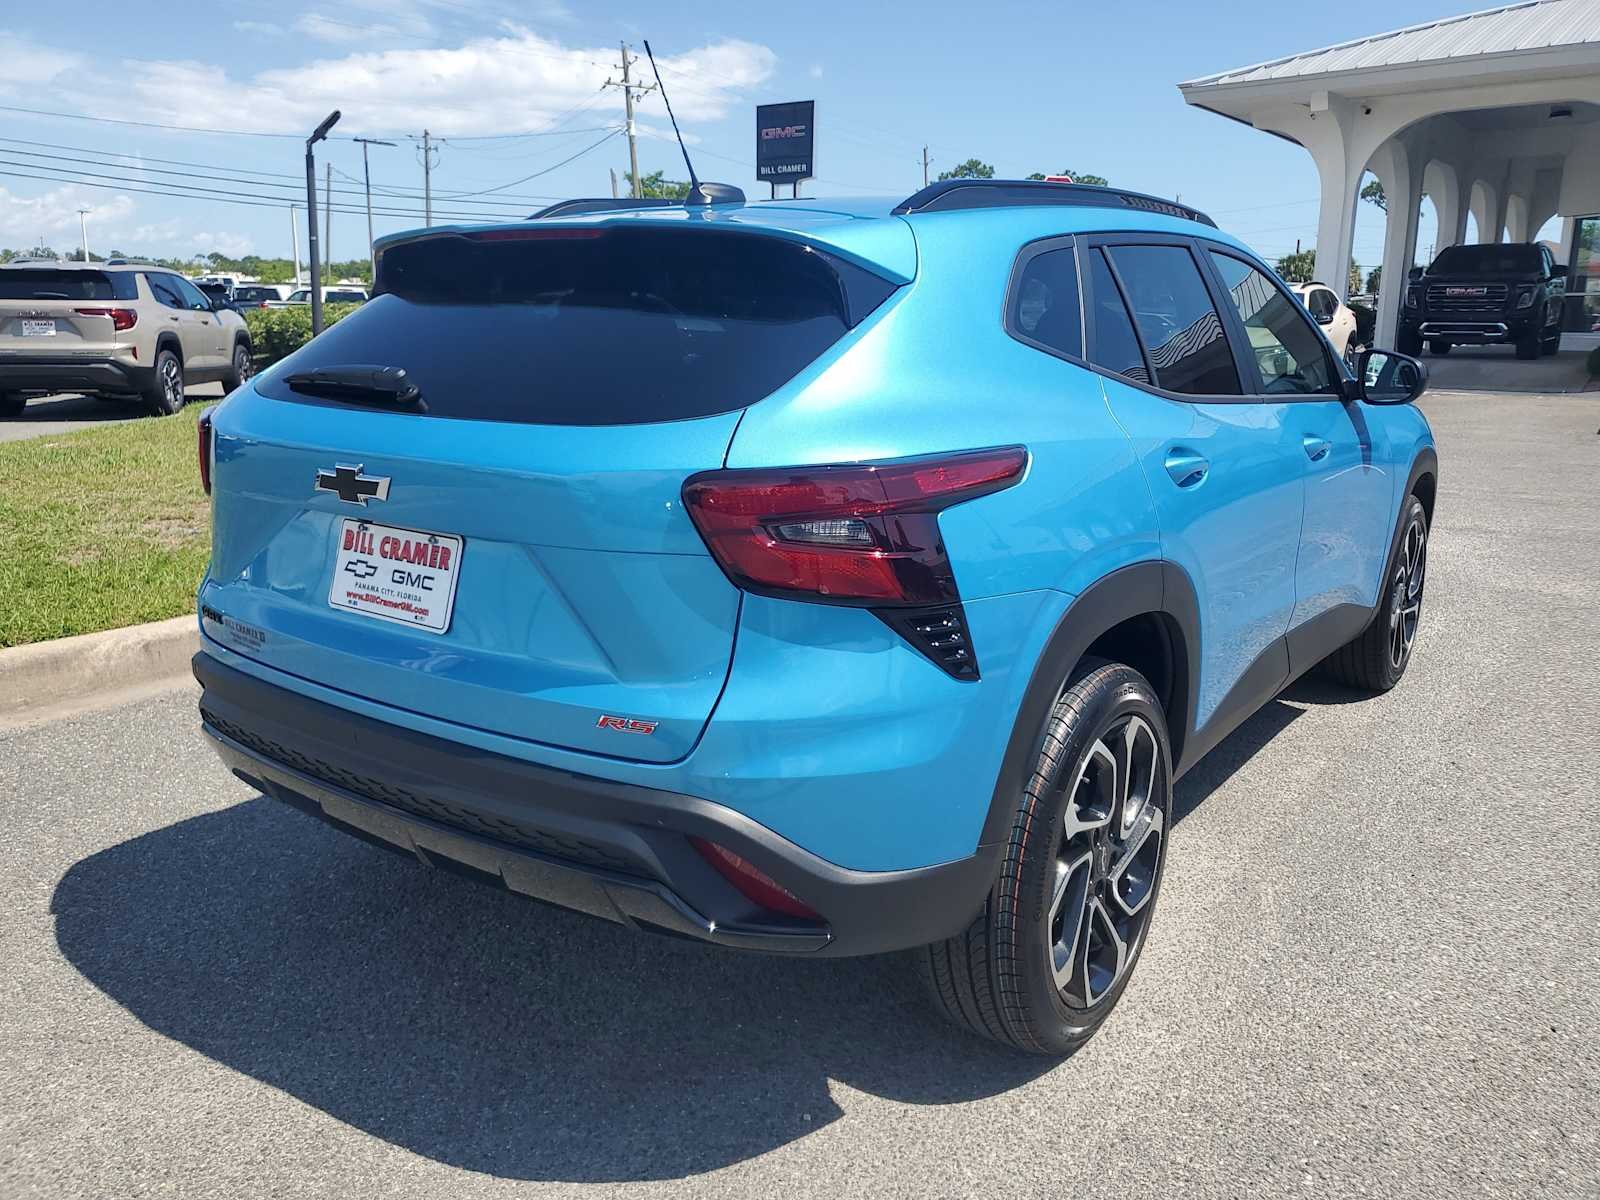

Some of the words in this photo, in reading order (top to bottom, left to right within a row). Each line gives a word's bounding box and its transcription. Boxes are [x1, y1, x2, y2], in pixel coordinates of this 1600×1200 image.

[762, 125, 806, 140] GMC
[760, 165, 776, 175] BILL
[777, 163, 807, 174] CRAMER
[343, 529, 374, 555] BILL
[380, 536, 451, 571] CRAMER
[391, 569, 435, 591] GMC
[355, 581, 380, 592] PANAMA
[396, 592, 422, 603] FLORIDA
[596, 714, 660, 735] RS
